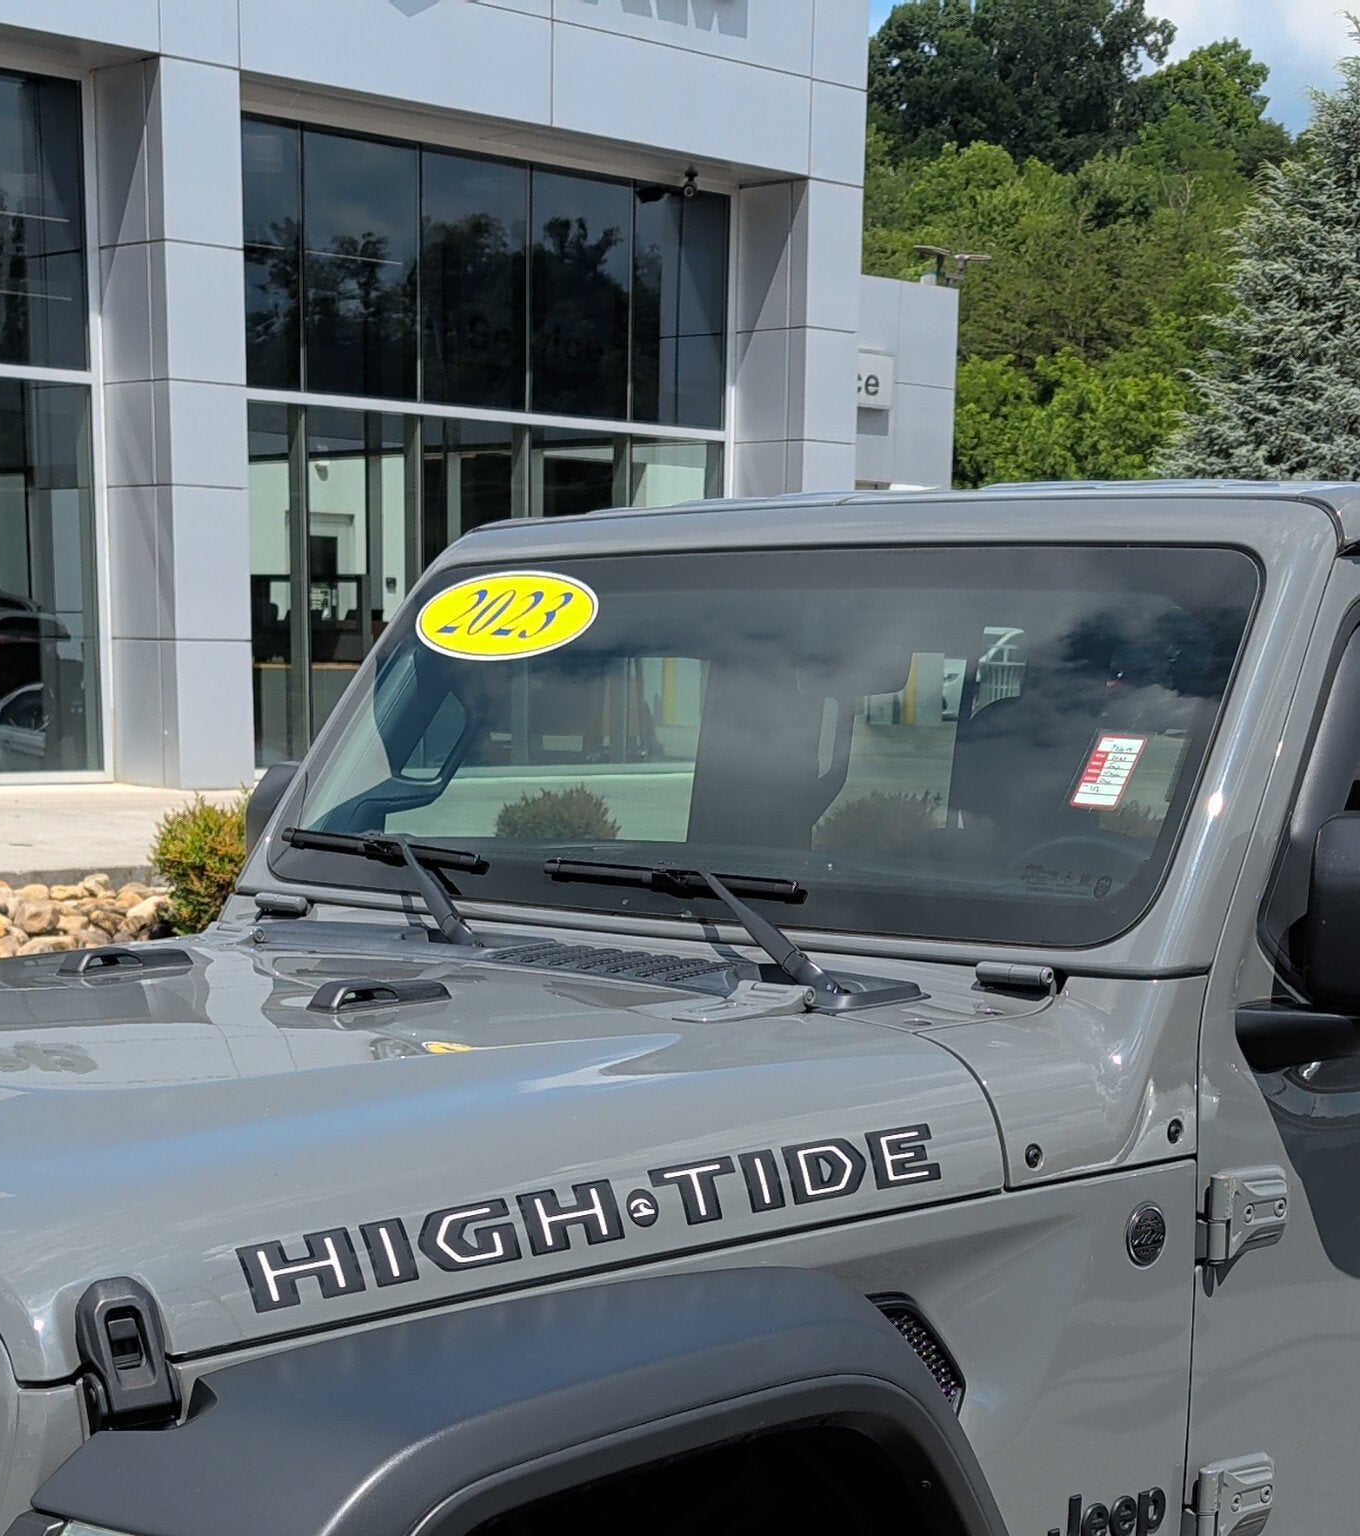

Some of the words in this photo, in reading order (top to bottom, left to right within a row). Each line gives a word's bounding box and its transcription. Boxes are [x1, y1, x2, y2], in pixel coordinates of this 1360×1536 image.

[434, 588, 575, 639] 2023
[234, 1178, 626, 1315] HIGH
[647, 1122, 943, 1227] TIDE
